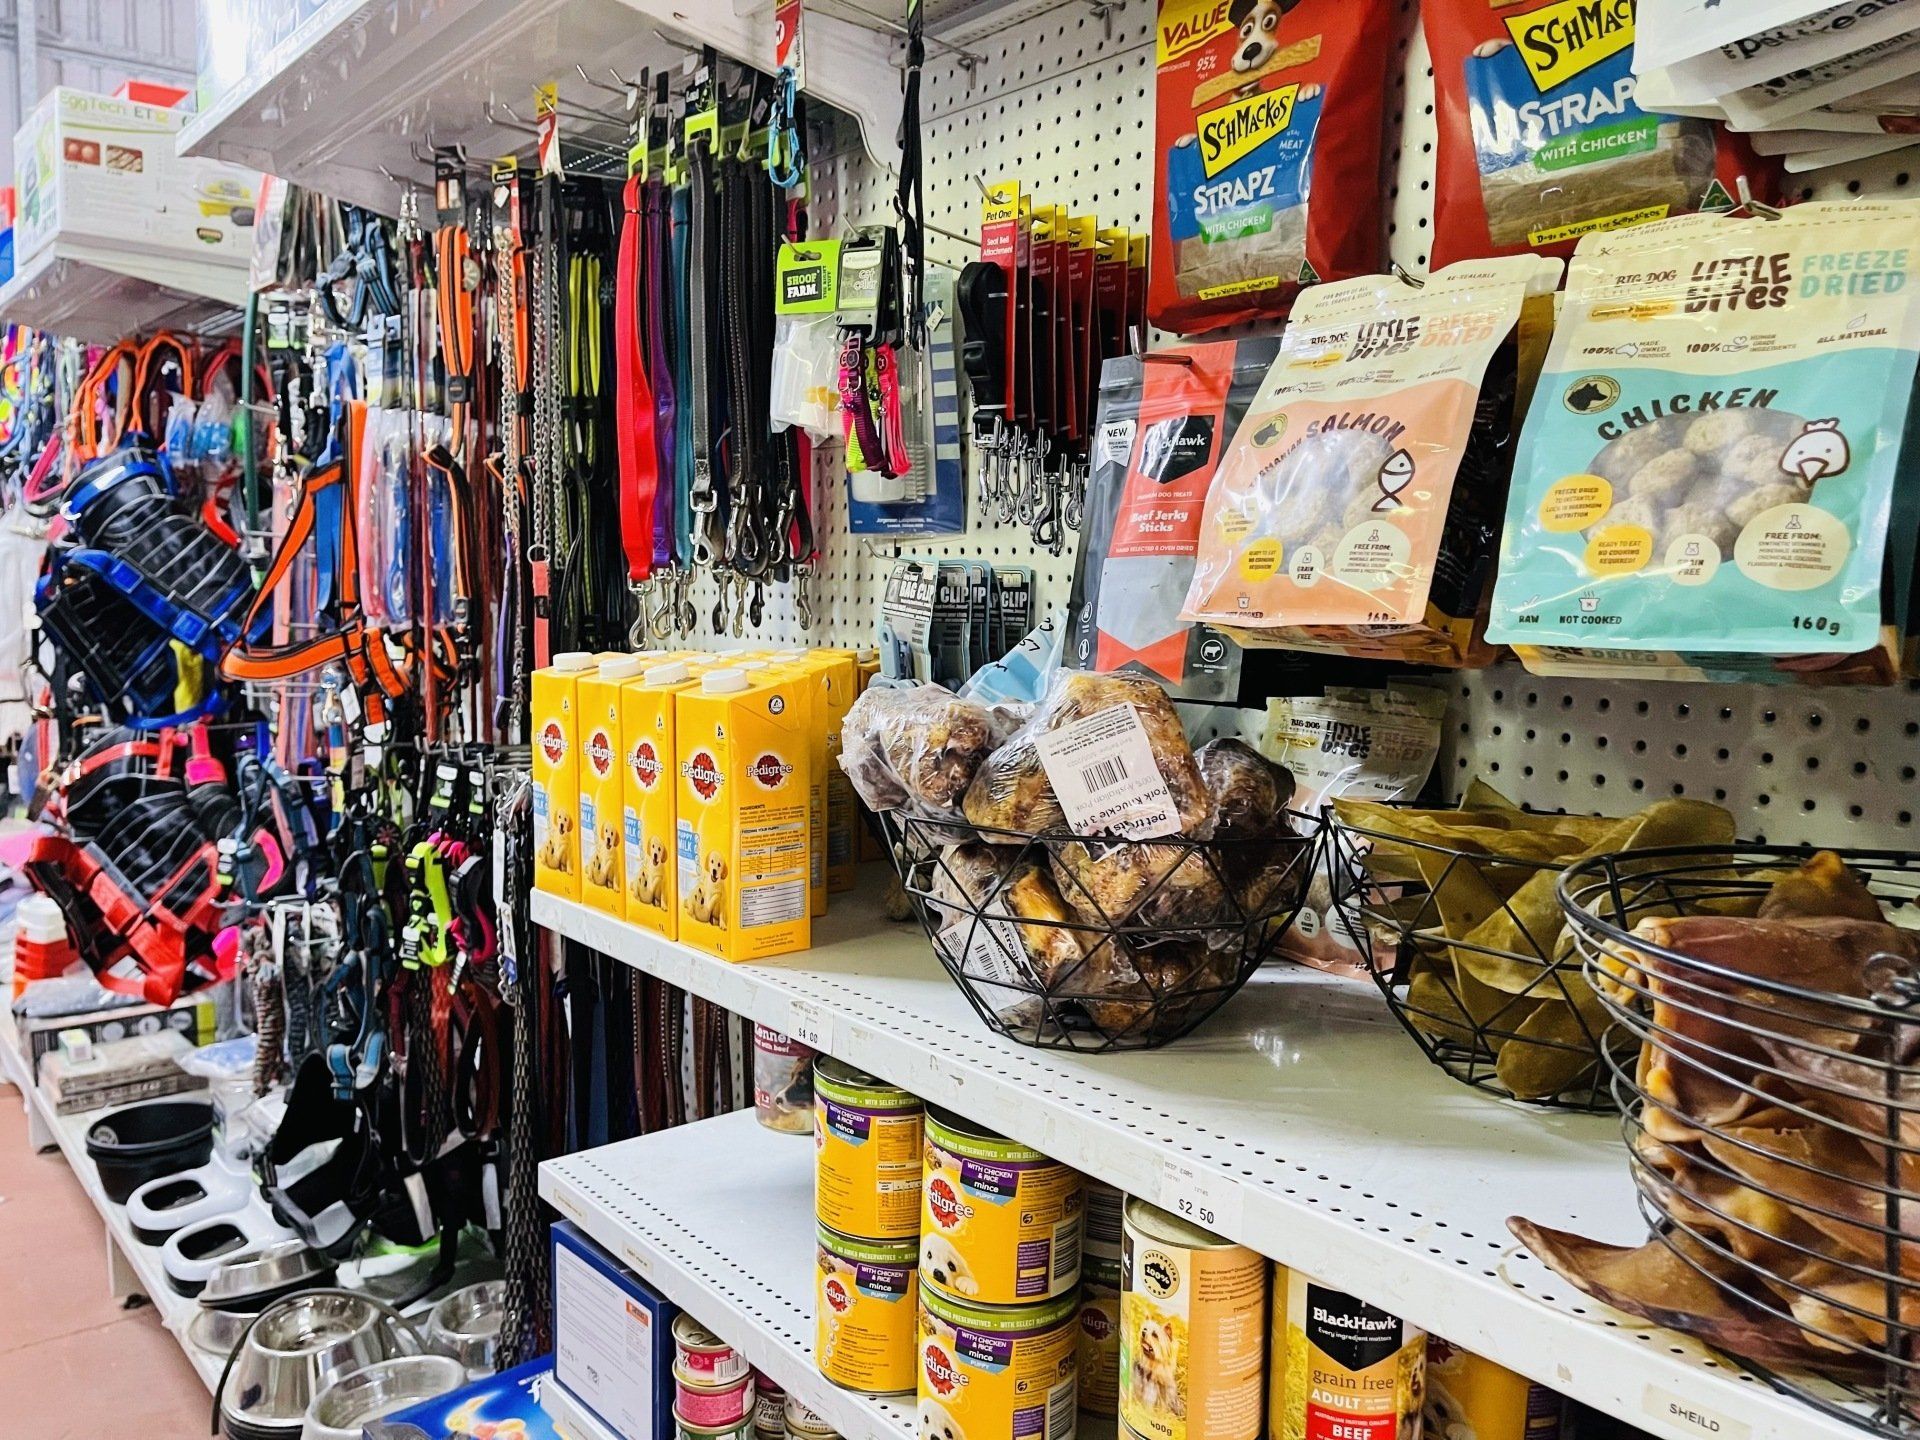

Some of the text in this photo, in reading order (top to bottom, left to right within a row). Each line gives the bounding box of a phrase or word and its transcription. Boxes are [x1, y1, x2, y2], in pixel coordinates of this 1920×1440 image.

[1163, 0, 1230, 48] VALUE
[1524, 0, 1638, 72] SCHMAC
[1196, 55, 1218, 72] 95%
[1519, 77, 1638, 140] STRAP
[1204, 96, 1290, 162] SCHMACKOS
[1279, 139, 1304, 150] MEAT
[1541, 128, 1648, 162] WITH CHICKEN
[1194, 166, 1276, 215] STRAPZ
[986, 211, 1012, 222] Pet One
[1206, 214, 1266, 236] WITH CHICKEN
[986, 237, 998, 246] Seat
[1691, 252, 1792, 286] LITTLE
[1803, 249, 1910, 274] FREEZE
[786, 272, 818, 288] SHOOF
[1646, 270, 1678, 285] DOG
[1800, 271, 1907, 299] DRIED
[1420, 326, 1496, 348] DRIED
[1817, 328, 1888, 344] ALL NATURAL
[1582, 346, 1616, 355] 100%
[1686, 342, 1722, 354] 100%
[1598, 388, 1780, 441] CHICKEN
[1107, 428, 1128, 438] NEW
[1306, 412, 1406, 443] SALMON
[1130, 510, 1189, 523] Beef Jerky
[1555, 512, 1589, 520] NUTRITION
[1138, 522, 1174, 533] Sticks
[1764, 532, 1822, 540] FREE FROM:
[899, 581, 936, 602] BAG CLIP
[940, 586, 971, 604] CLIP
[1001, 592, 1028, 608] CLIP
[1518, 616, 1623, 625] RAW NOT COOKED
[1792, 616, 1841, 636] 160g
[1305, 720, 1321, 730] DOG
[536, 732, 569, 751] Pedigree
[584, 741, 616, 761] Pedigree
[627, 752, 664, 773] Pedigree
[681, 761, 726, 786] Pedigree
[746, 764, 794, 778] Pedigree
[1144, 786, 1168, 803] Pork
[1091, 816, 1098, 824] 3
[1144, 811, 1168, 826] pet
[680, 838, 692, 853] MILK
[774, 1044, 790, 1053] beef
[829, 1105, 865, 1123] WITH CHICKEN
[841, 1117, 853, 1126] RICE
[835, 1122, 855, 1135] mince
[958, 1145, 998, 1158] PRESERVATIVES
[968, 1163, 1013, 1180] WITH CHICKEN
[984, 1174, 999, 1184] RICE
[974, 1182, 1000, 1194] mince
[926, 1187, 975, 1218] edigree
[858, 1251, 896, 1261] PRESERVATIVES
[862, 1267, 904, 1278] WITH CHICKEN
[877, 1275, 892, 1283] RICE
[1147, 1265, 1171, 1286] 100%
[869, 1282, 892, 1292] mince
[824, 1286, 857, 1306] edigree
[952, 1313, 992, 1328] PRESERVATIVES
[1016, 1319, 1036, 1328] SELECT
[1313, 1306, 1398, 1331] BlackHawk
[962, 1331, 1008, 1348] WITH CHICKEN
[1318, 1327, 1335, 1338] Every
[1336, 1331, 1368, 1343] ingredient
[978, 1343, 994, 1353] RICE
[969, 1350, 994, 1363] mince
[921, 1352, 970, 1386] edigree
[1312, 1369, 1394, 1390] grain free
[758, 1400, 785, 1412] Fancy
[1311, 1388, 1361, 1410] ADULT
[759, 1409, 784, 1422] Feast
[1669, 1402, 1721, 1434] SHEILD
[1150, 1420, 1173, 1437] 400g
[1332, 1424, 1372, 1440] BEEF
